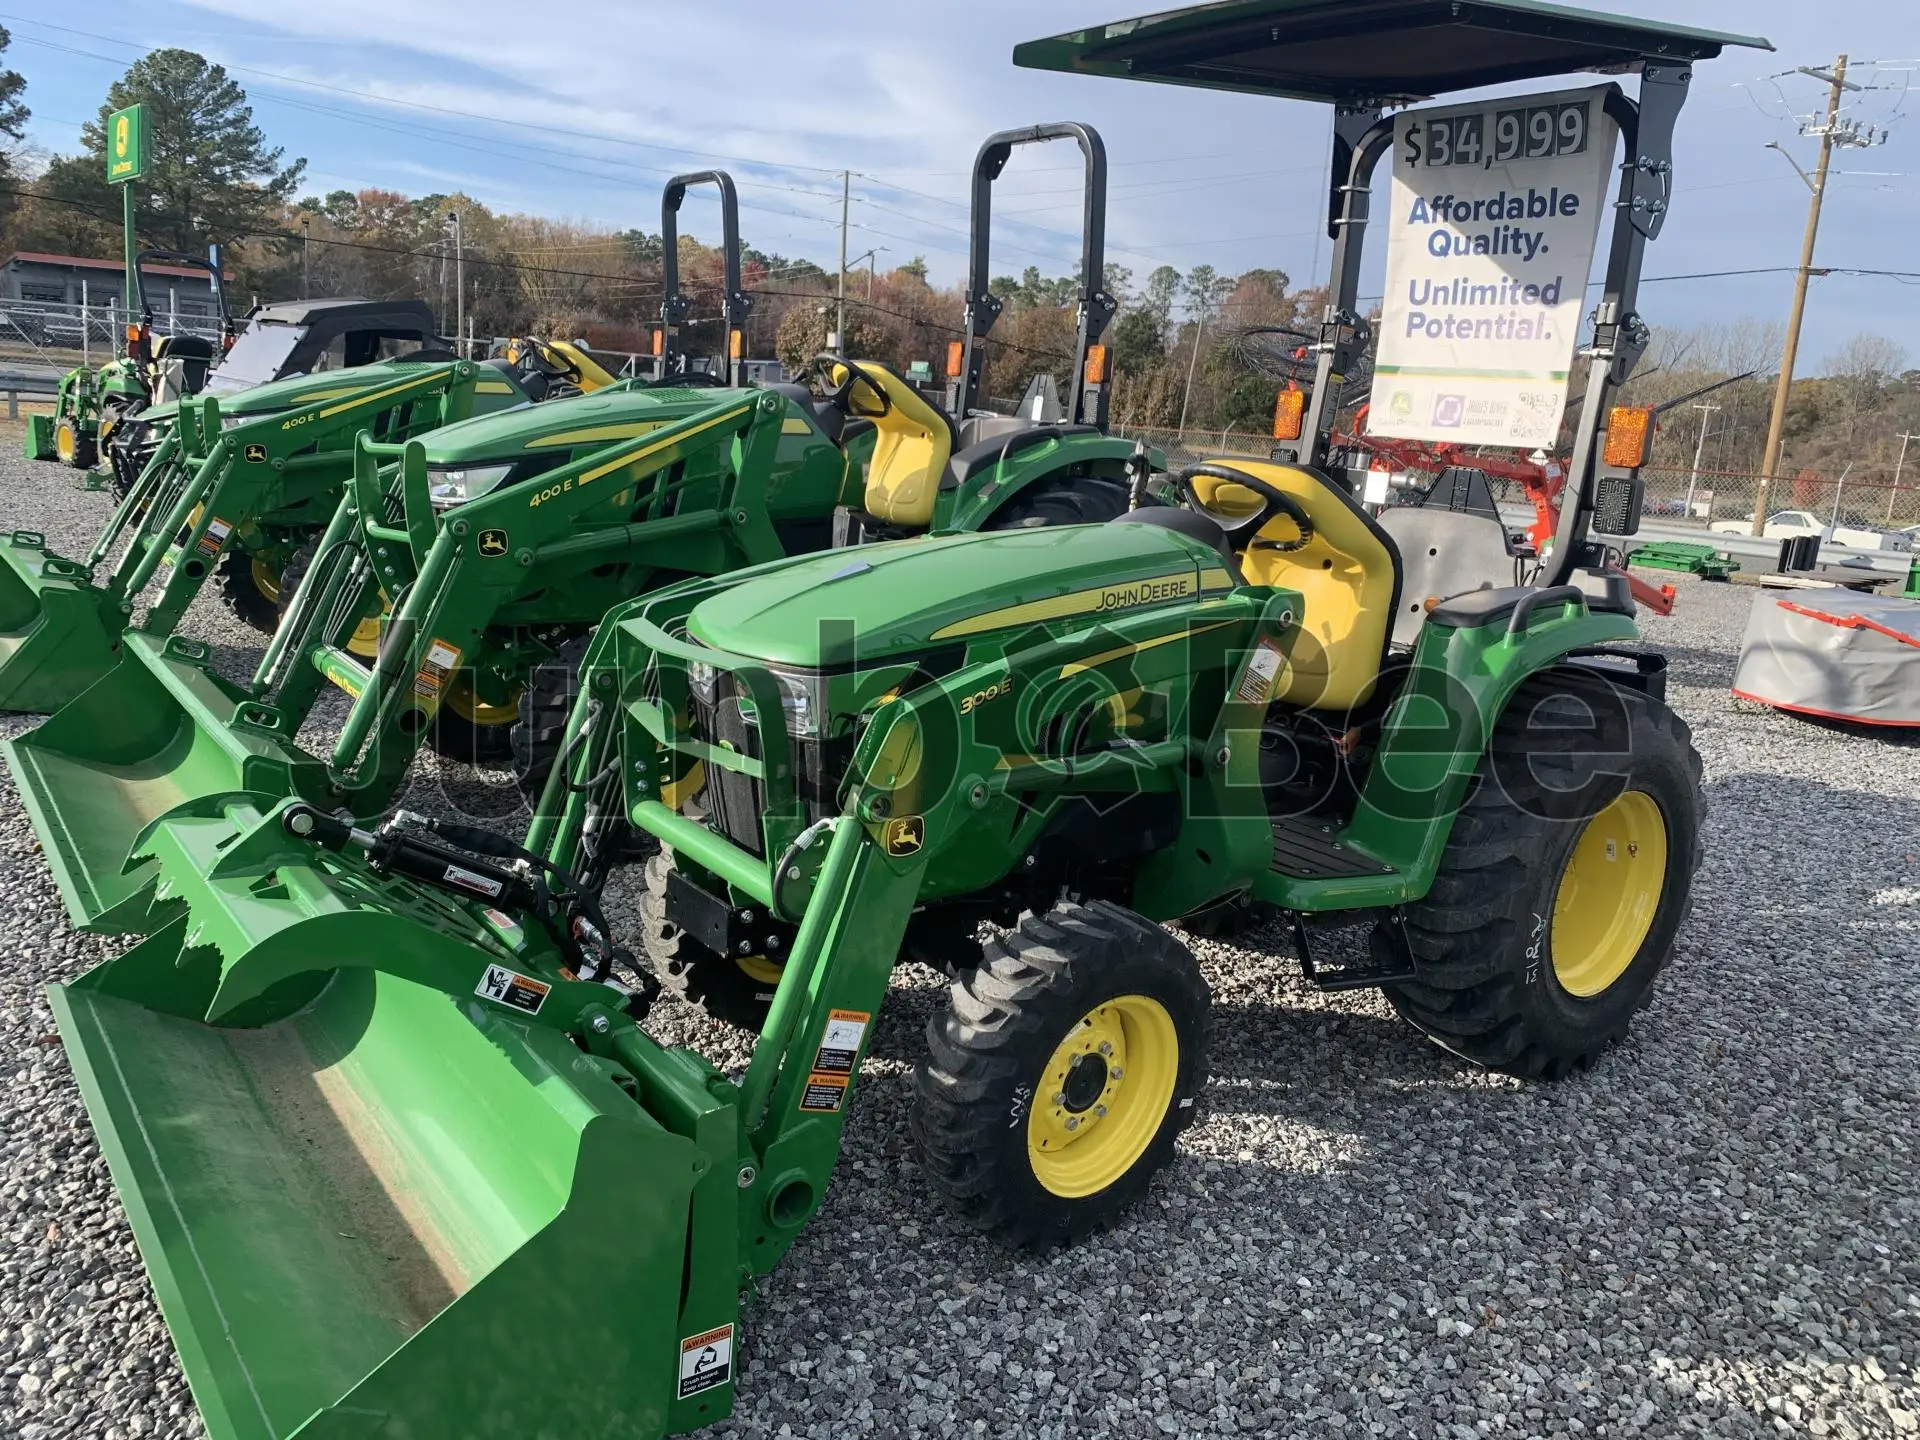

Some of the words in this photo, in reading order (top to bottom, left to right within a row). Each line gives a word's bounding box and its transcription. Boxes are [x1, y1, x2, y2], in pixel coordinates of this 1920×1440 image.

[1404, 106, 1588, 170] $34,999
[1408, 187, 1580, 225] Affordable
[1428, 226, 1549, 262] Quality.
[1408, 276, 1563, 306] Unlimited
[1405, 311, 1552, 341] Potential.
[1096, 588, 1138, 610] JOHN
[1141, 580, 1187, 601] DEERE
[692, 1328, 730, 1347] WARNING
